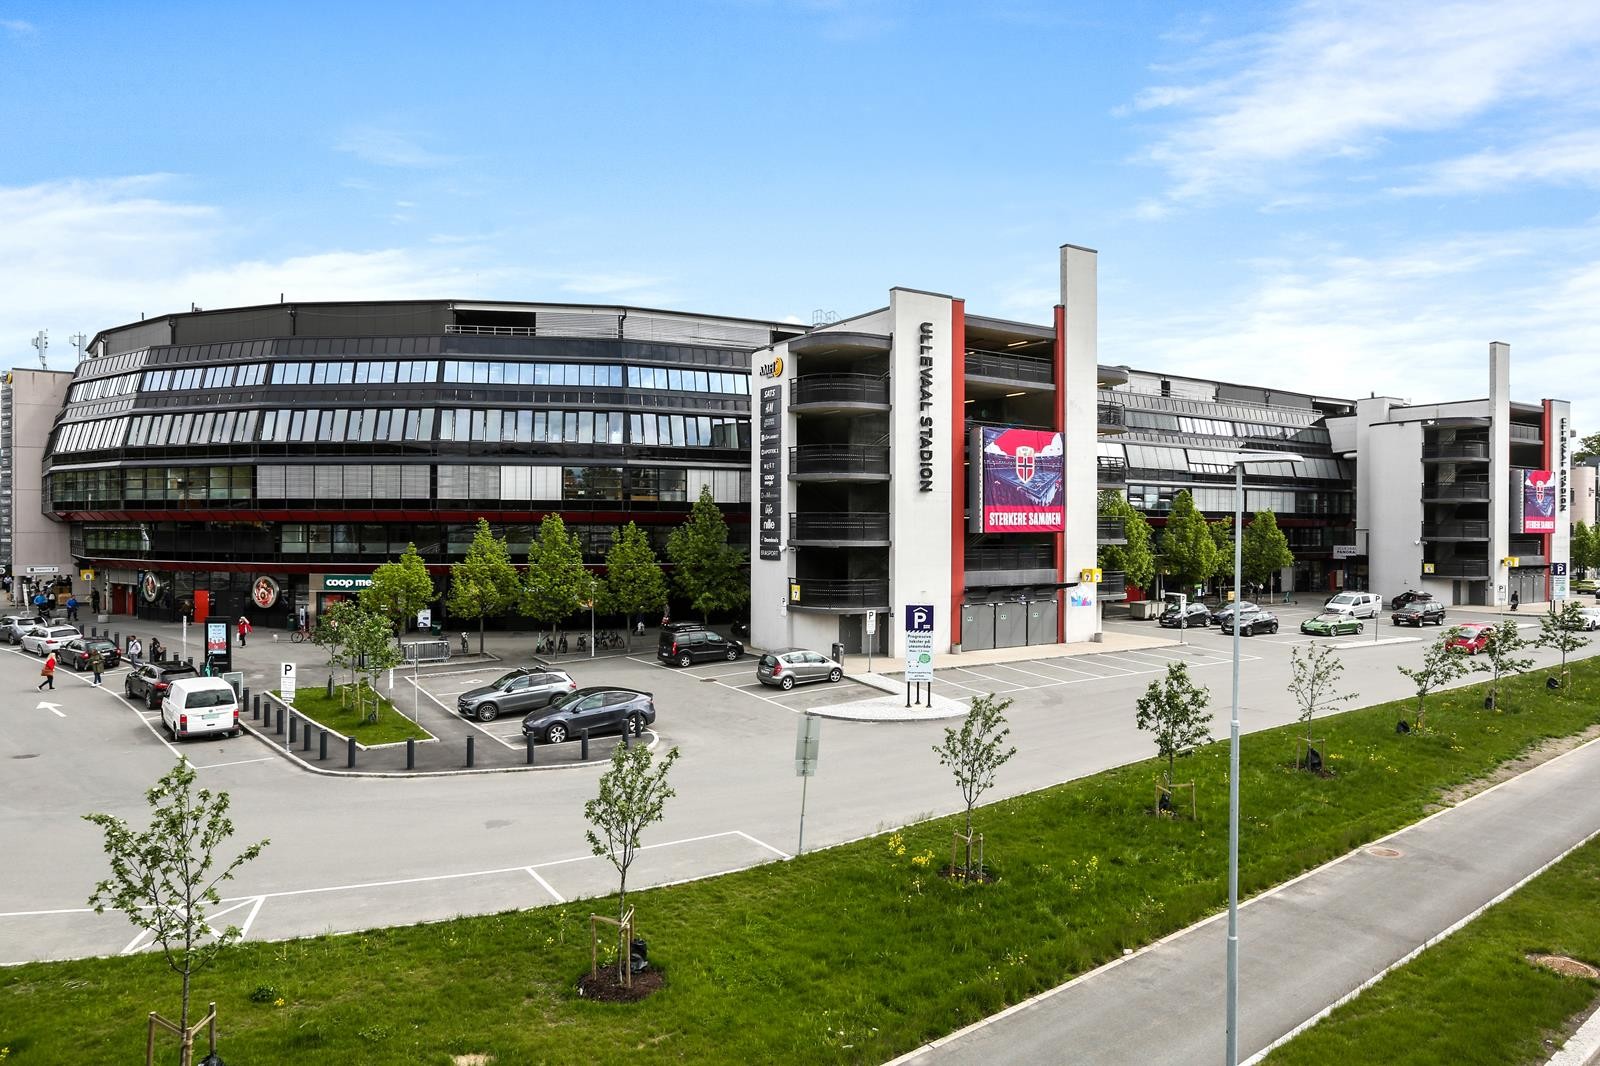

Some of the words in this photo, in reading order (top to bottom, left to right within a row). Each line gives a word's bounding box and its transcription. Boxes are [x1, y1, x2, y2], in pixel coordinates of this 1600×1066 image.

[918, 321, 933, 411] ULLEVAAL
[764, 389, 776, 398] SATS
[918, 415, 933, 492] STADION
[989, 511, 1028, 526] STERKERE
[1029, 511, 1061, 526] SAMMEN
[326, 579, 353, 588] coop
[868, 612, 874, 620] P
[914, 612, 927, 629] P
[284, 664, 292, 676] P
